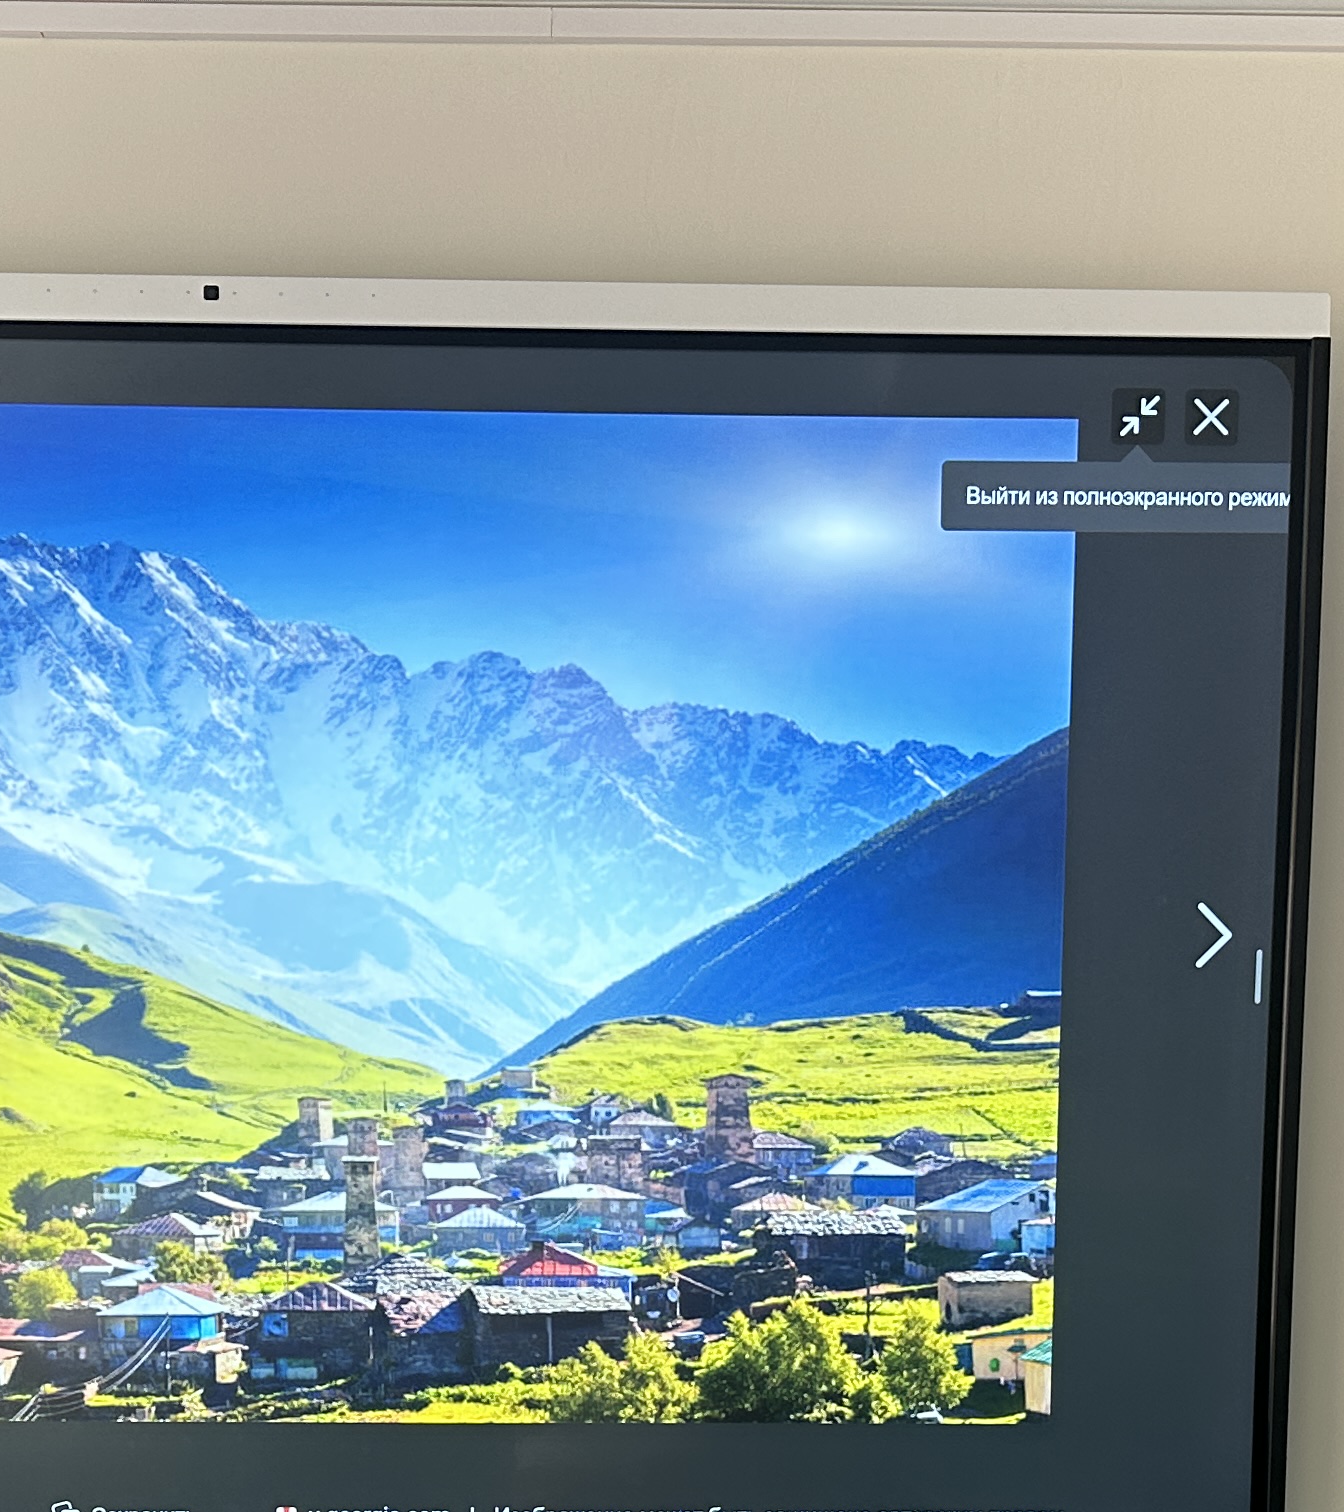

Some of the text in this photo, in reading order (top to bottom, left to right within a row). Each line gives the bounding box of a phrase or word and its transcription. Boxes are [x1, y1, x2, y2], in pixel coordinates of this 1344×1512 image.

[965, 485, 1031, 507] Выйти
[1035, 490, 1059, 507] из
[1063, 490, 1224, 512] полноэкранного
